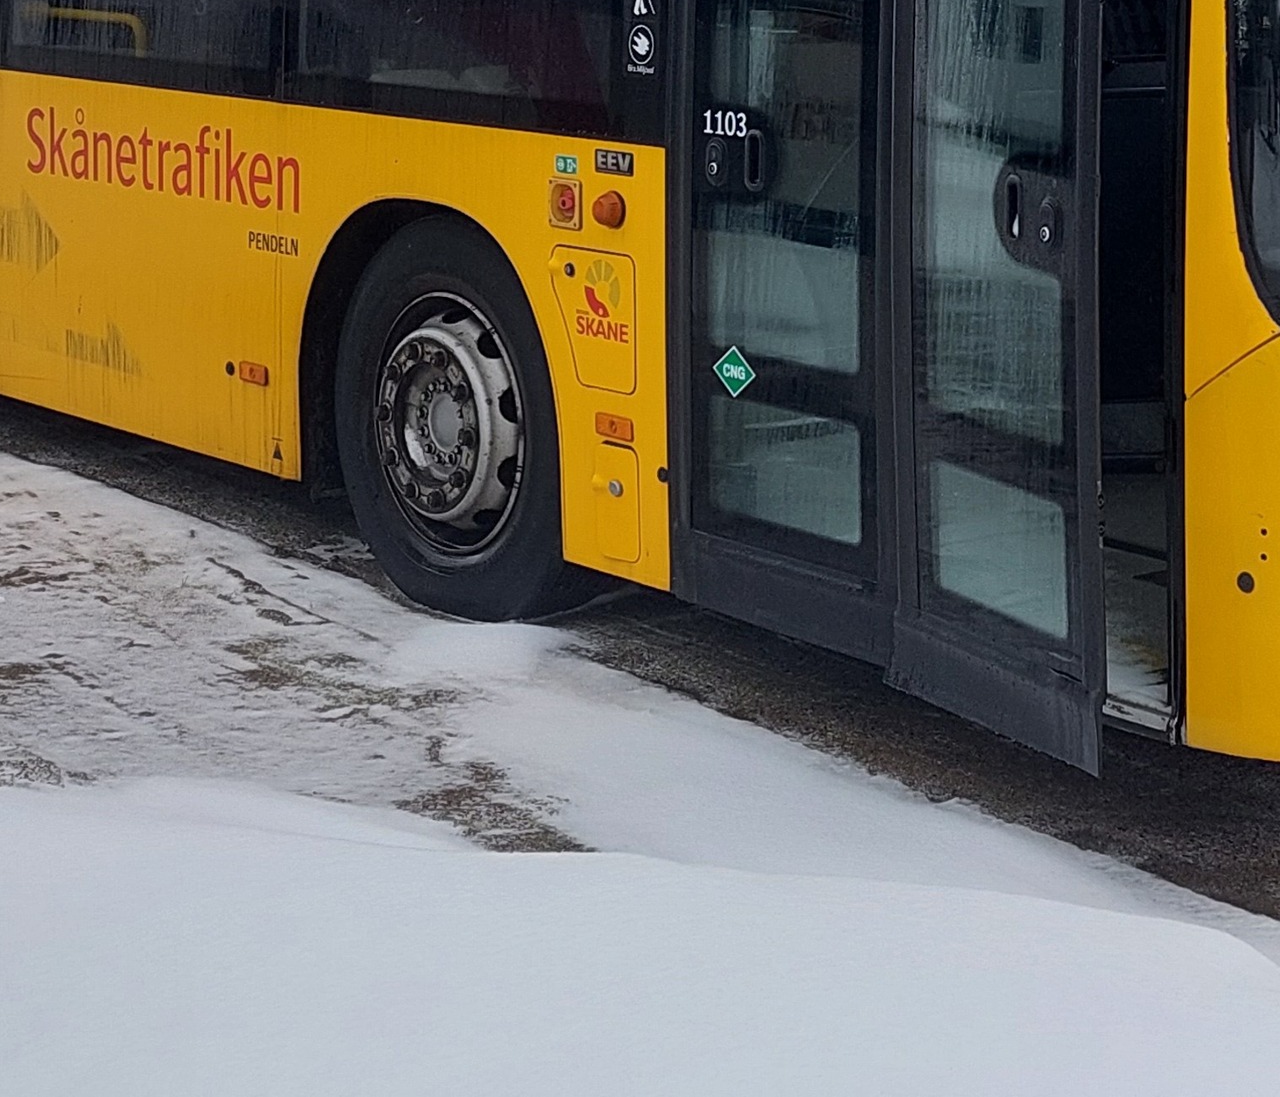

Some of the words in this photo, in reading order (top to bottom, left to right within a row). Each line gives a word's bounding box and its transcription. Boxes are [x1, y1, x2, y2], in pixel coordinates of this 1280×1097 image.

[703, 108, 747, 138] 1103
[26, 106, 301, 214] Skånetrafiken
[596, 150, 632, 172] EEV
[248, 230, 299, 257] PENDELN
[723, 365, 746, 380] CNG
